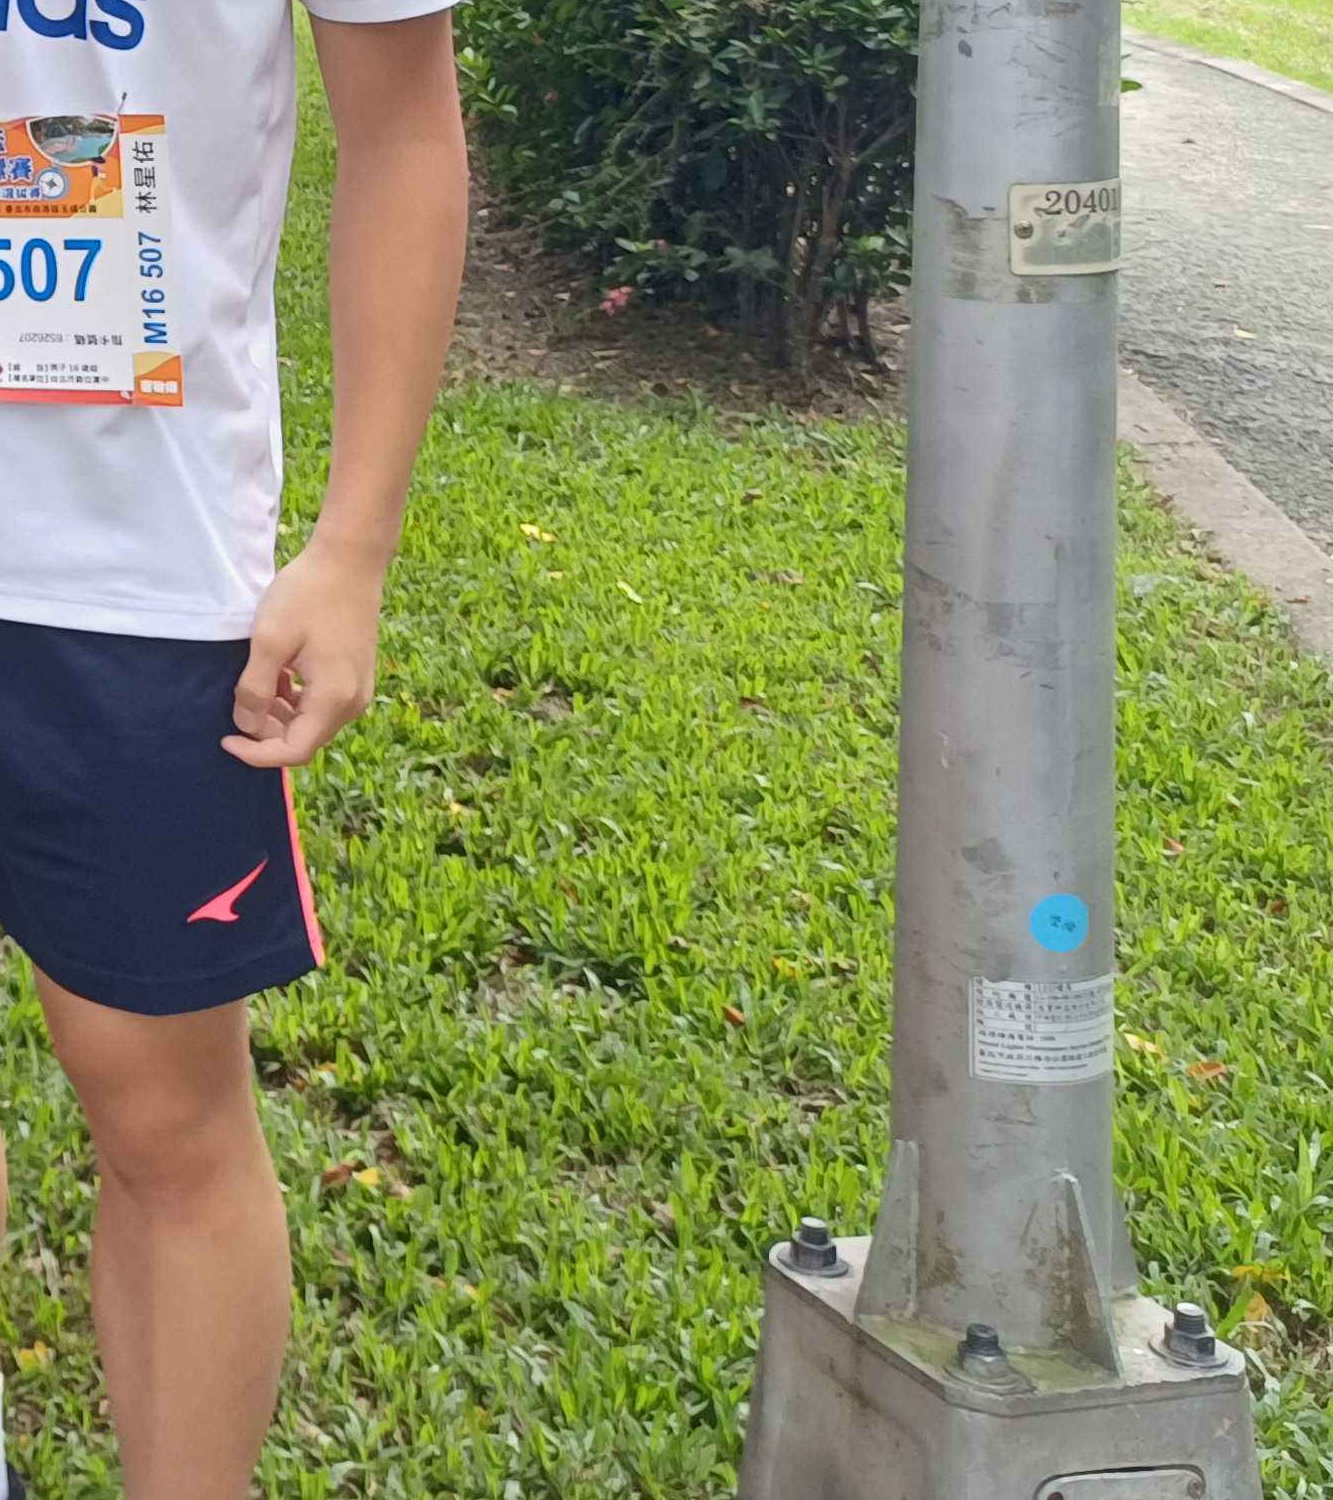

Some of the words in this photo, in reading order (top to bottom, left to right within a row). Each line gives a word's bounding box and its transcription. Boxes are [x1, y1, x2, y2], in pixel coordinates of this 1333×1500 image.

[131, 140, 159, 215] 林星佑
[138, 231, 165, 280] 507
[140, 288, 169, 345] M16
